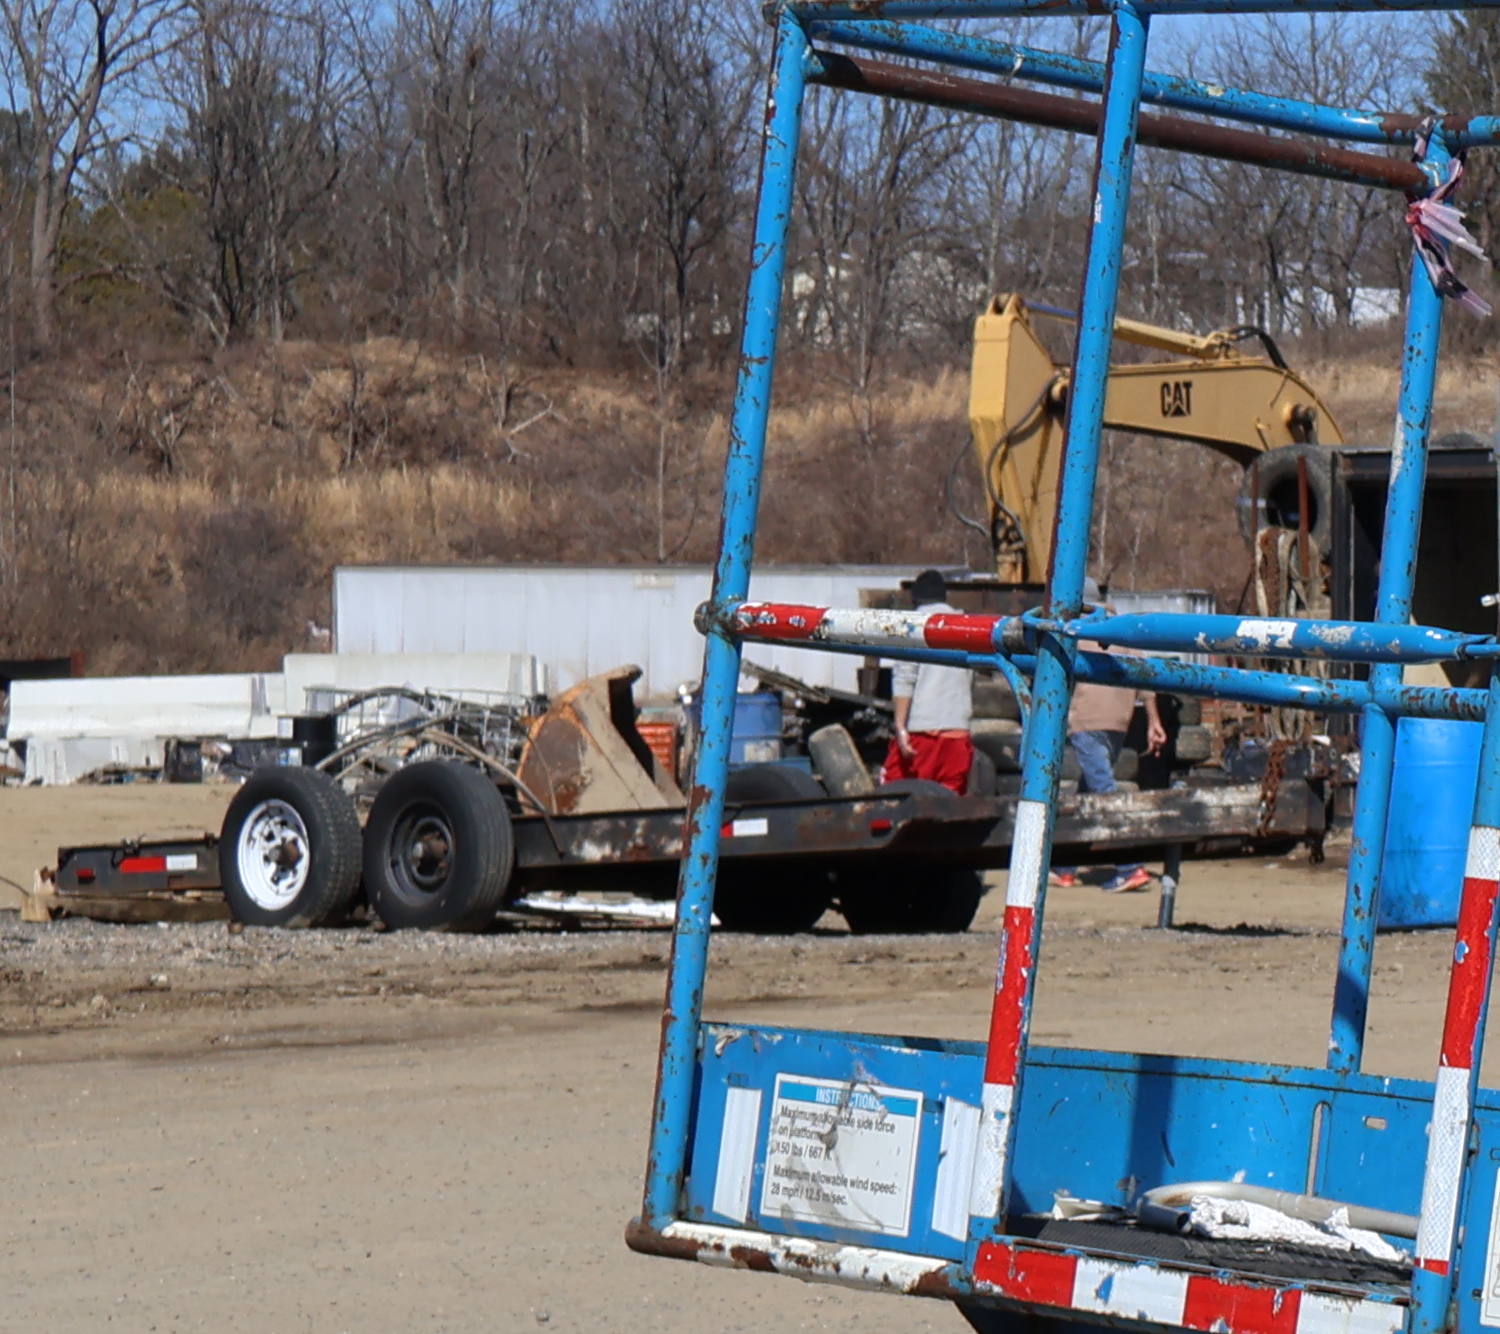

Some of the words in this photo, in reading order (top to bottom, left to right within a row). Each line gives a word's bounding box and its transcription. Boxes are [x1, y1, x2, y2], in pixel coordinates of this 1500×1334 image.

[1160, 380, 1193, 418] CAT
[856, 1117, 873, 1130] side
[874, 1118, 896, 1134] force
[791, 1143, 803, 1157] lbs
[808, 1145, 824, 1159] 667
[773, 1164, 811, 1182] Maximum
[811, 1171, 848, 1187] allowable
[849, 1176, 869, 1191] wind
[770, 1182, 780, 1196] 28
[781, 1185, 799, 1200] mph
[805, 1187, 821, 1202] 12.5
